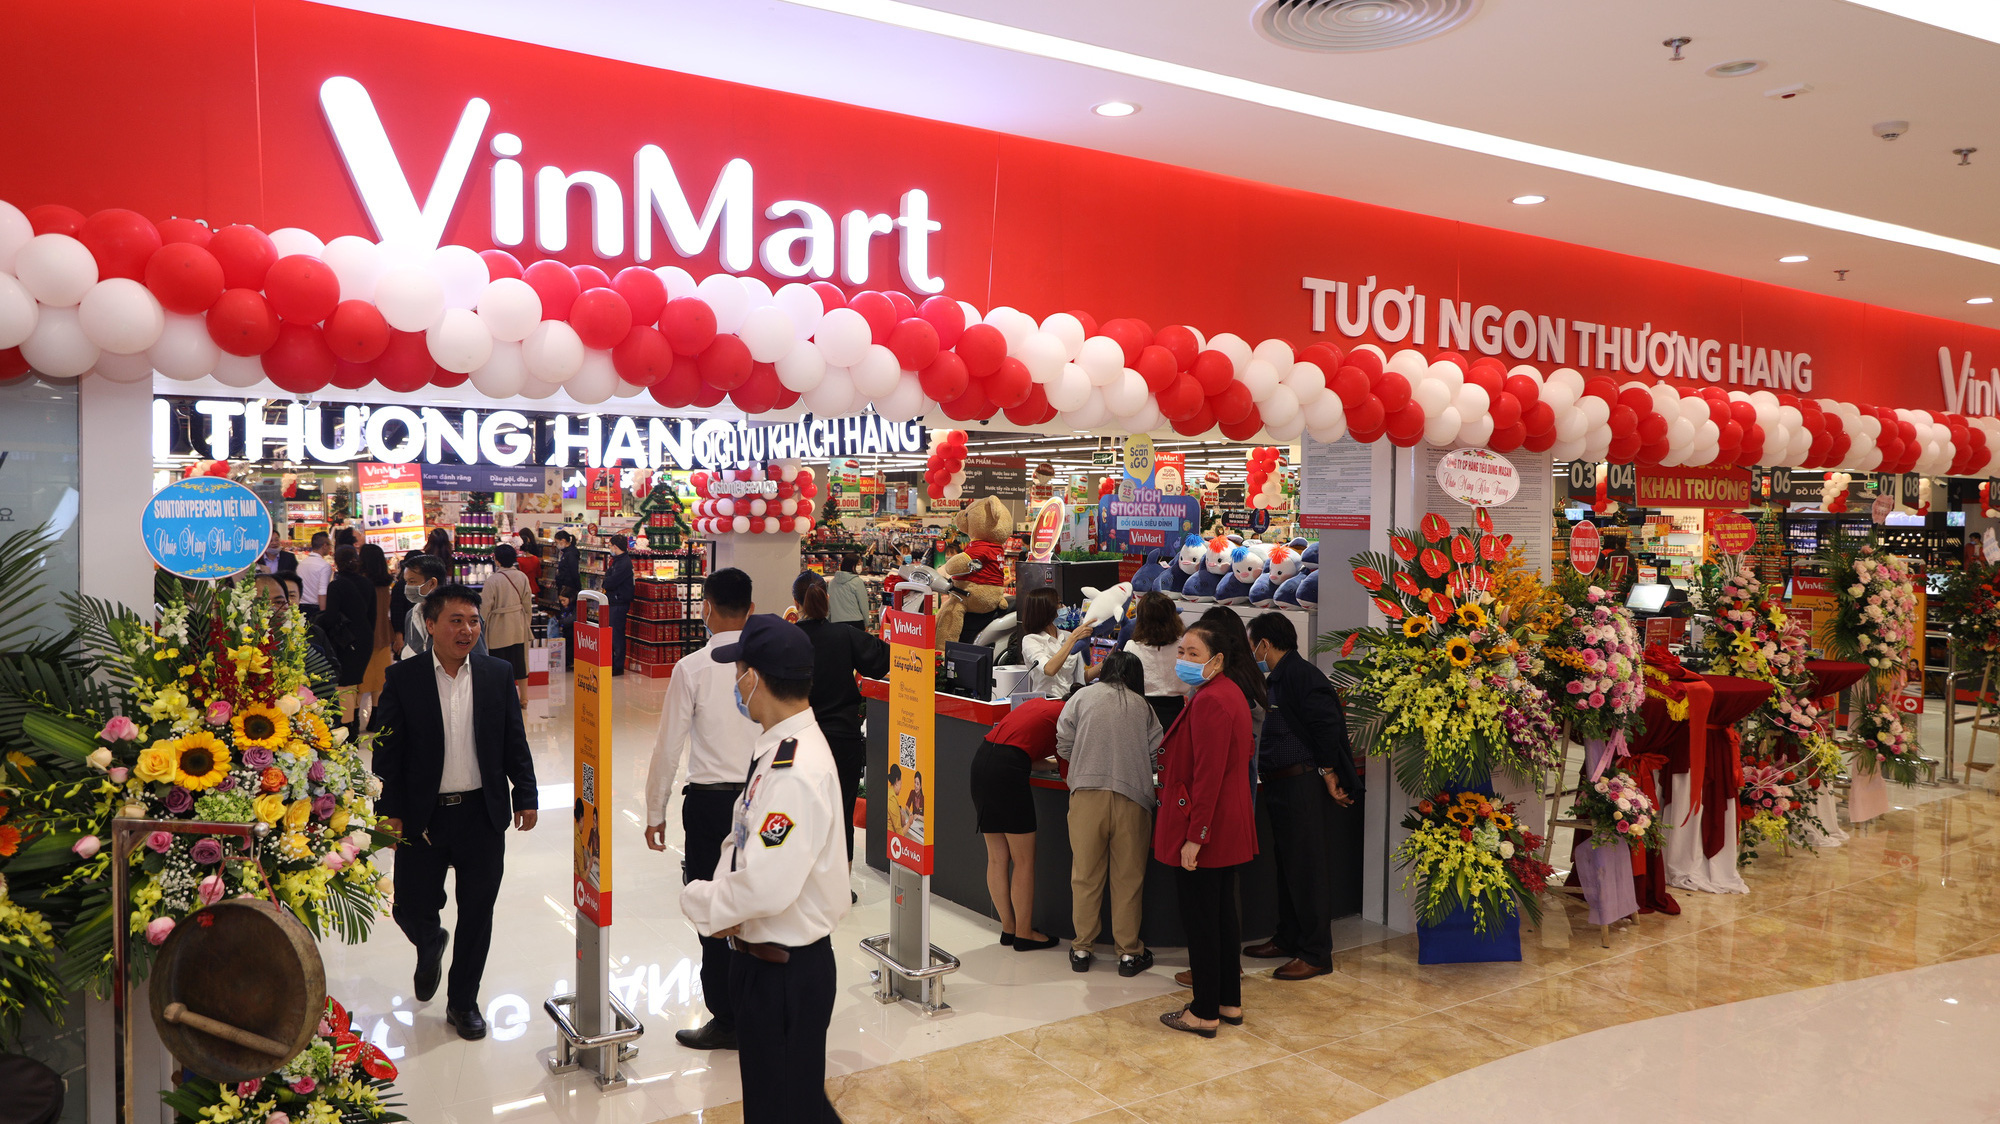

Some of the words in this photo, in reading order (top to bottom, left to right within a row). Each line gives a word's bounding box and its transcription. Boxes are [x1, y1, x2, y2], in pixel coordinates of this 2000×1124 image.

[319, 75, 946, 296] VinMart
[1302, 274, 1426, 346] TƯƠI
[1438, 297, 1566, 364] NGON
[767, 413, 840, 460] KHÁCH
[1130, 447, 1149, 457] Scan
[1155, 454, 1179, 463] VinMart
[364, 465, 407, 477] VinMrt
[439, 473, 456, 481] đánh
[1571, 462, 1595, 489] 03
[1610, 463, 1633, 489] 04
[1641, 476, 1681, 499] KHAI
[1684, 476, 1749, 502] TRƯƠNG
[1773, 470, 1791, 494] 06
[1795, 486, 1809, 496] ĐỒ
[1880, 475, 1896, 495] 07
[1904, 477, 1919, 498] 08
[1122, 488, 1132, 497] 25
[1134, 487, 1162, 503] TÍCH
[154, 498, 222, 519] SUNTORYPEPSICO
[222, 495, 239, 521] VIỆT
[240, 498, 258, 517] NAM
[1110, 501, 1158, 516] STICKER
[1158, 504, 1187, 518] XINH
[1131, 517, 1144, 527] QUÀ
[1144, 518, 1157, 527] SIÊU
[153, 527, 178, 562] Chúc
[207, 526, 232, 556] Khai
[1130, 531, 1162, 544] VinMart
[1615, 562, 1624, 581] 7
[894, 618, 923, 637] VinMart
[576, 630, 598, 652] VinMart
[909, 850, 921, 862] VÀO
